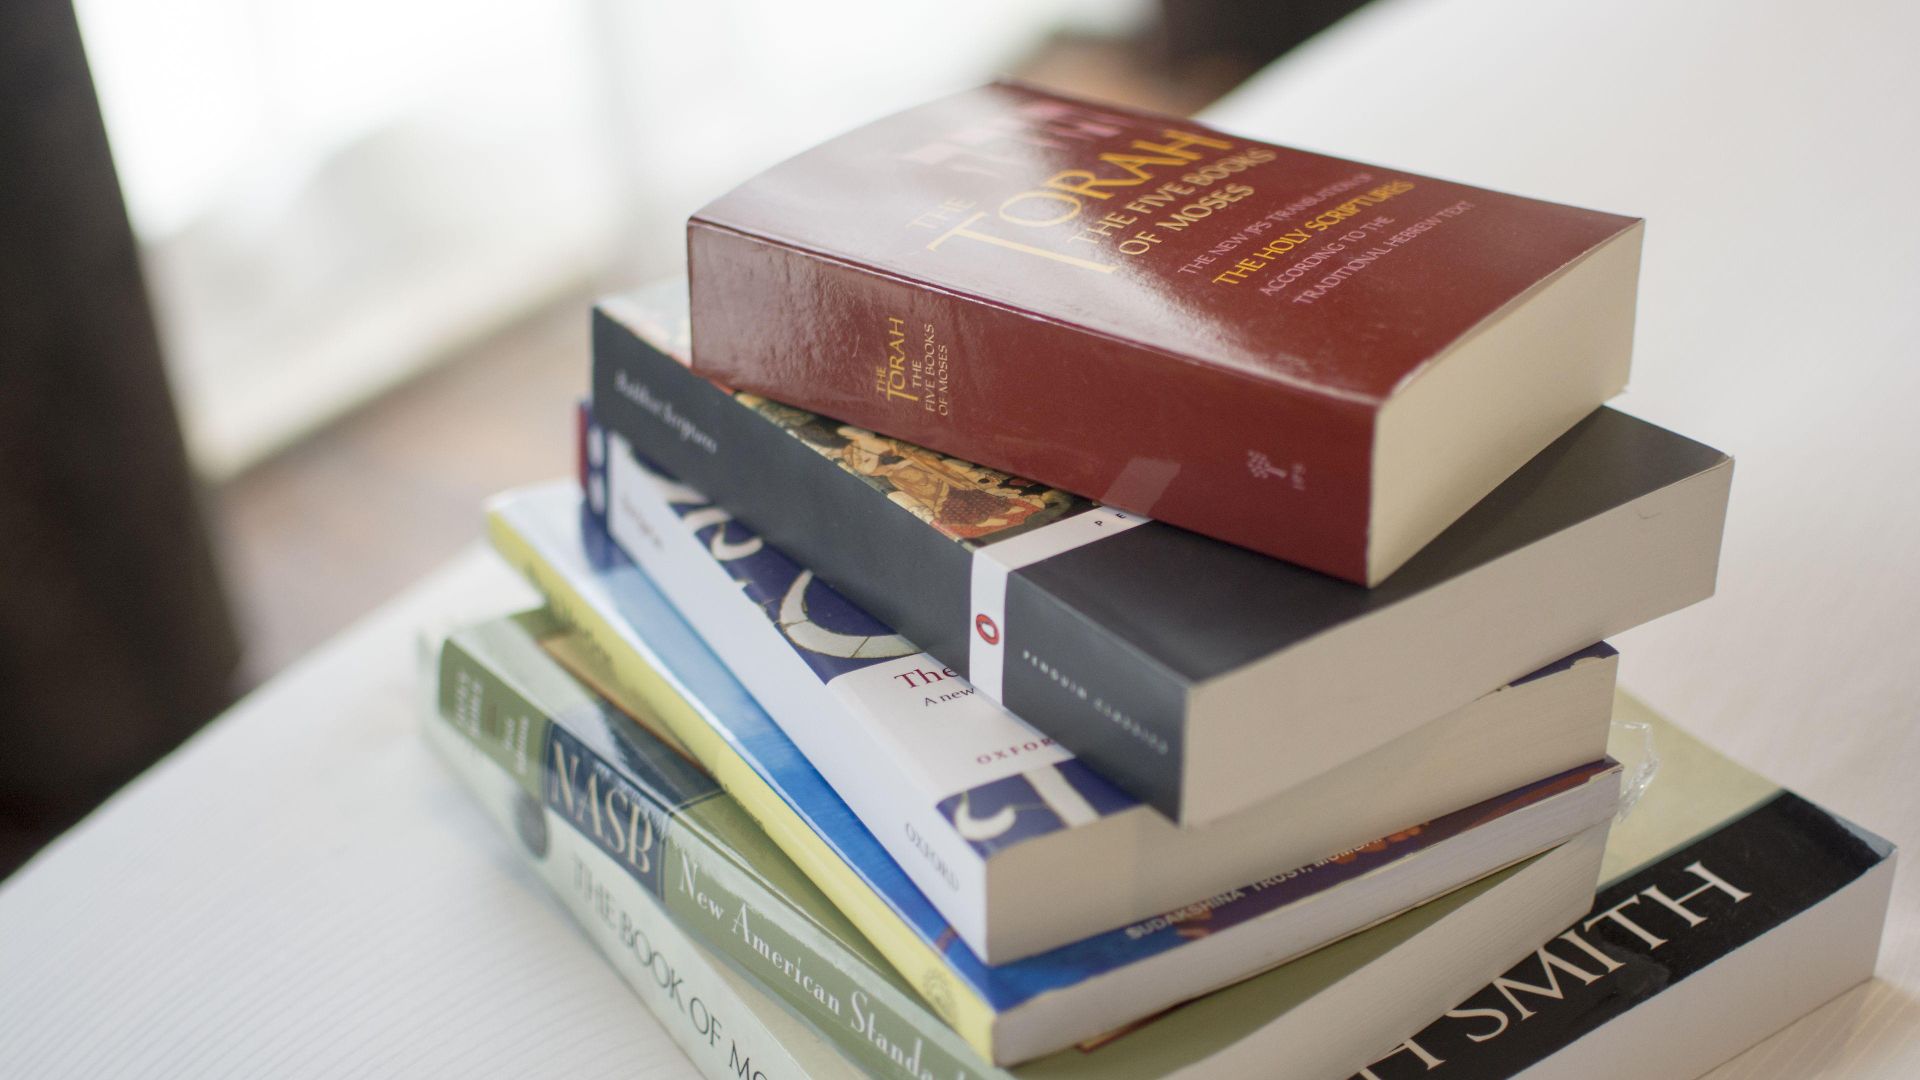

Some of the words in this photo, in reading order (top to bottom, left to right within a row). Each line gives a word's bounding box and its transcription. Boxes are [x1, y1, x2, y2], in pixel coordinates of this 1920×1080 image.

[905, 197, 976, 232] THE
[926, 128, 1234, 274] TORAH
[1068, 211, 1138, 246] THE
[1136, 181, 1194, 215] FIVE
[1182, 147, 1277, 187] BOOKS
[1118, 230, 1163, 256] OF
[1157, 182, 1255, 232] MOSES
[1178, 254, 1216, 275] THE
[1208, 231, 1248, 257] NEW
[1212, 252, 1266, 286] THE
[1261, 229, 1312, 260] HOLY
[1305, 180, 1416, 232] SCRIPTURES
[1259, 242, 1346, 297] ACCORDING
[1338, 230, 1367, 246] TO
[1360, 215, 1396, 232] THE
[1292, 246, 1392, 306] TRADITIONAL
[1383, 214, 1443, 248] HEBREW
[1436, 199, 1477, 220] TEXT
[876, 366, 886, 392] THE
[887, 317, 919, 401] TORAH
[912, 359, 922, 388] THE
[924, 323, 935, 376] BOOKS
[938, 345, 948, 393] MOSES
[925, 379, 935, 412] FIVE
[939, 398, 948, 416] OF
[893, 667, 959, 689] The
[924, 697, 938, 707] A
[940, 687, 976, 702] new
[976, 738, 1057, 764] OXFOR
[550, 739, 653, 874] NASB
[905, 822, 960, 892] OXFORD
[620, 910, 686, 1015] BOOK
[690, 997, 722, 1047] OF
[679, 850, 725, 921] New
[732, 902, 841, 1017] American
[850, 990, 966, 1080] Standa
[1443, 860, 1752, 1043] SMITH
